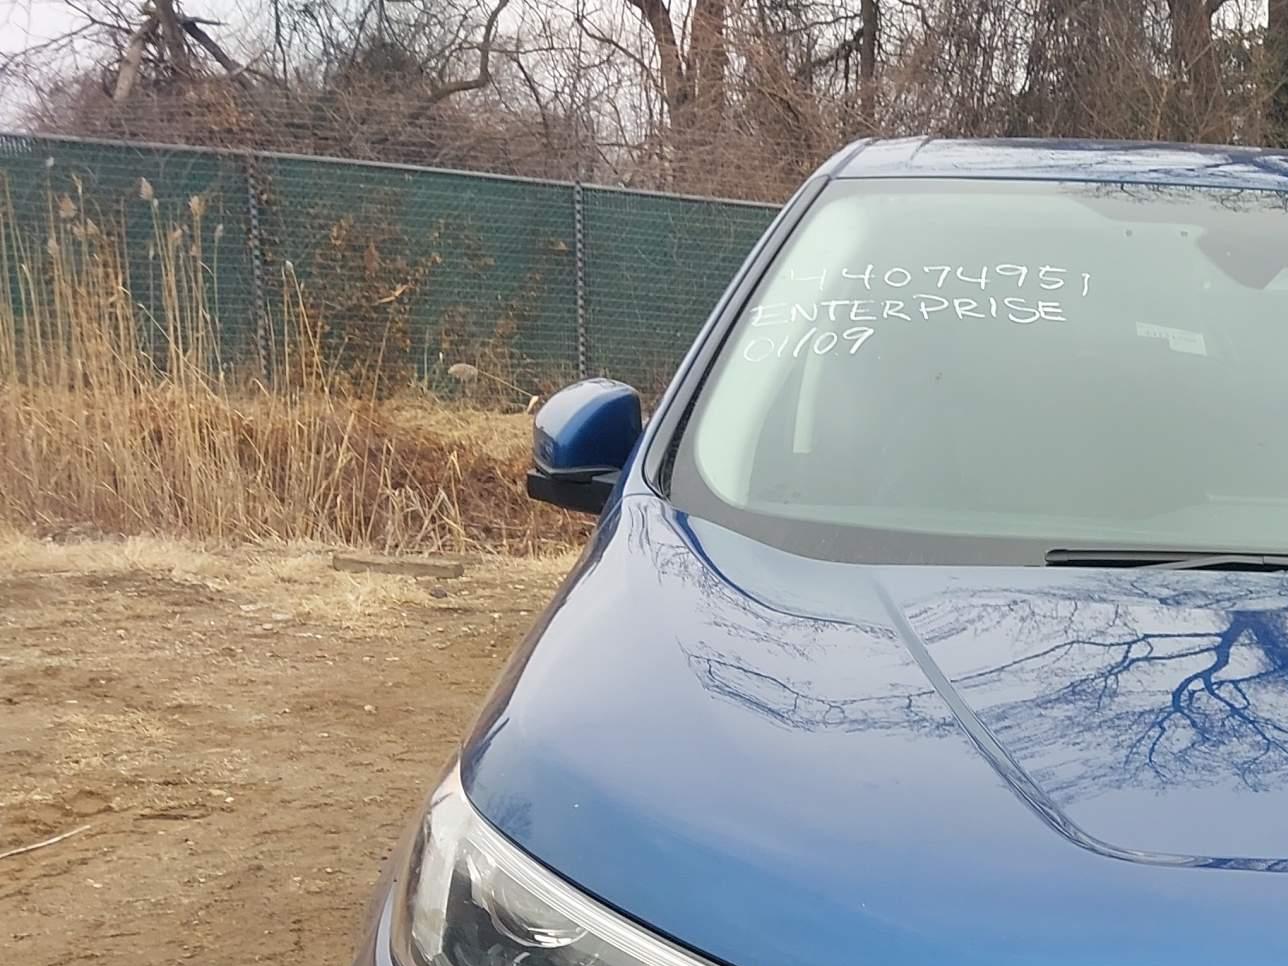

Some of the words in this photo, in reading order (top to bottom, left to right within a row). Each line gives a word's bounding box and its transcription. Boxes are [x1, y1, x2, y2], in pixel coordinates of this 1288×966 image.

[789, 263, 1091, 297] 44074951
[750, 294, 1067, 327] ENTERPRISE
[743, 326, 875, 362] 01/09
